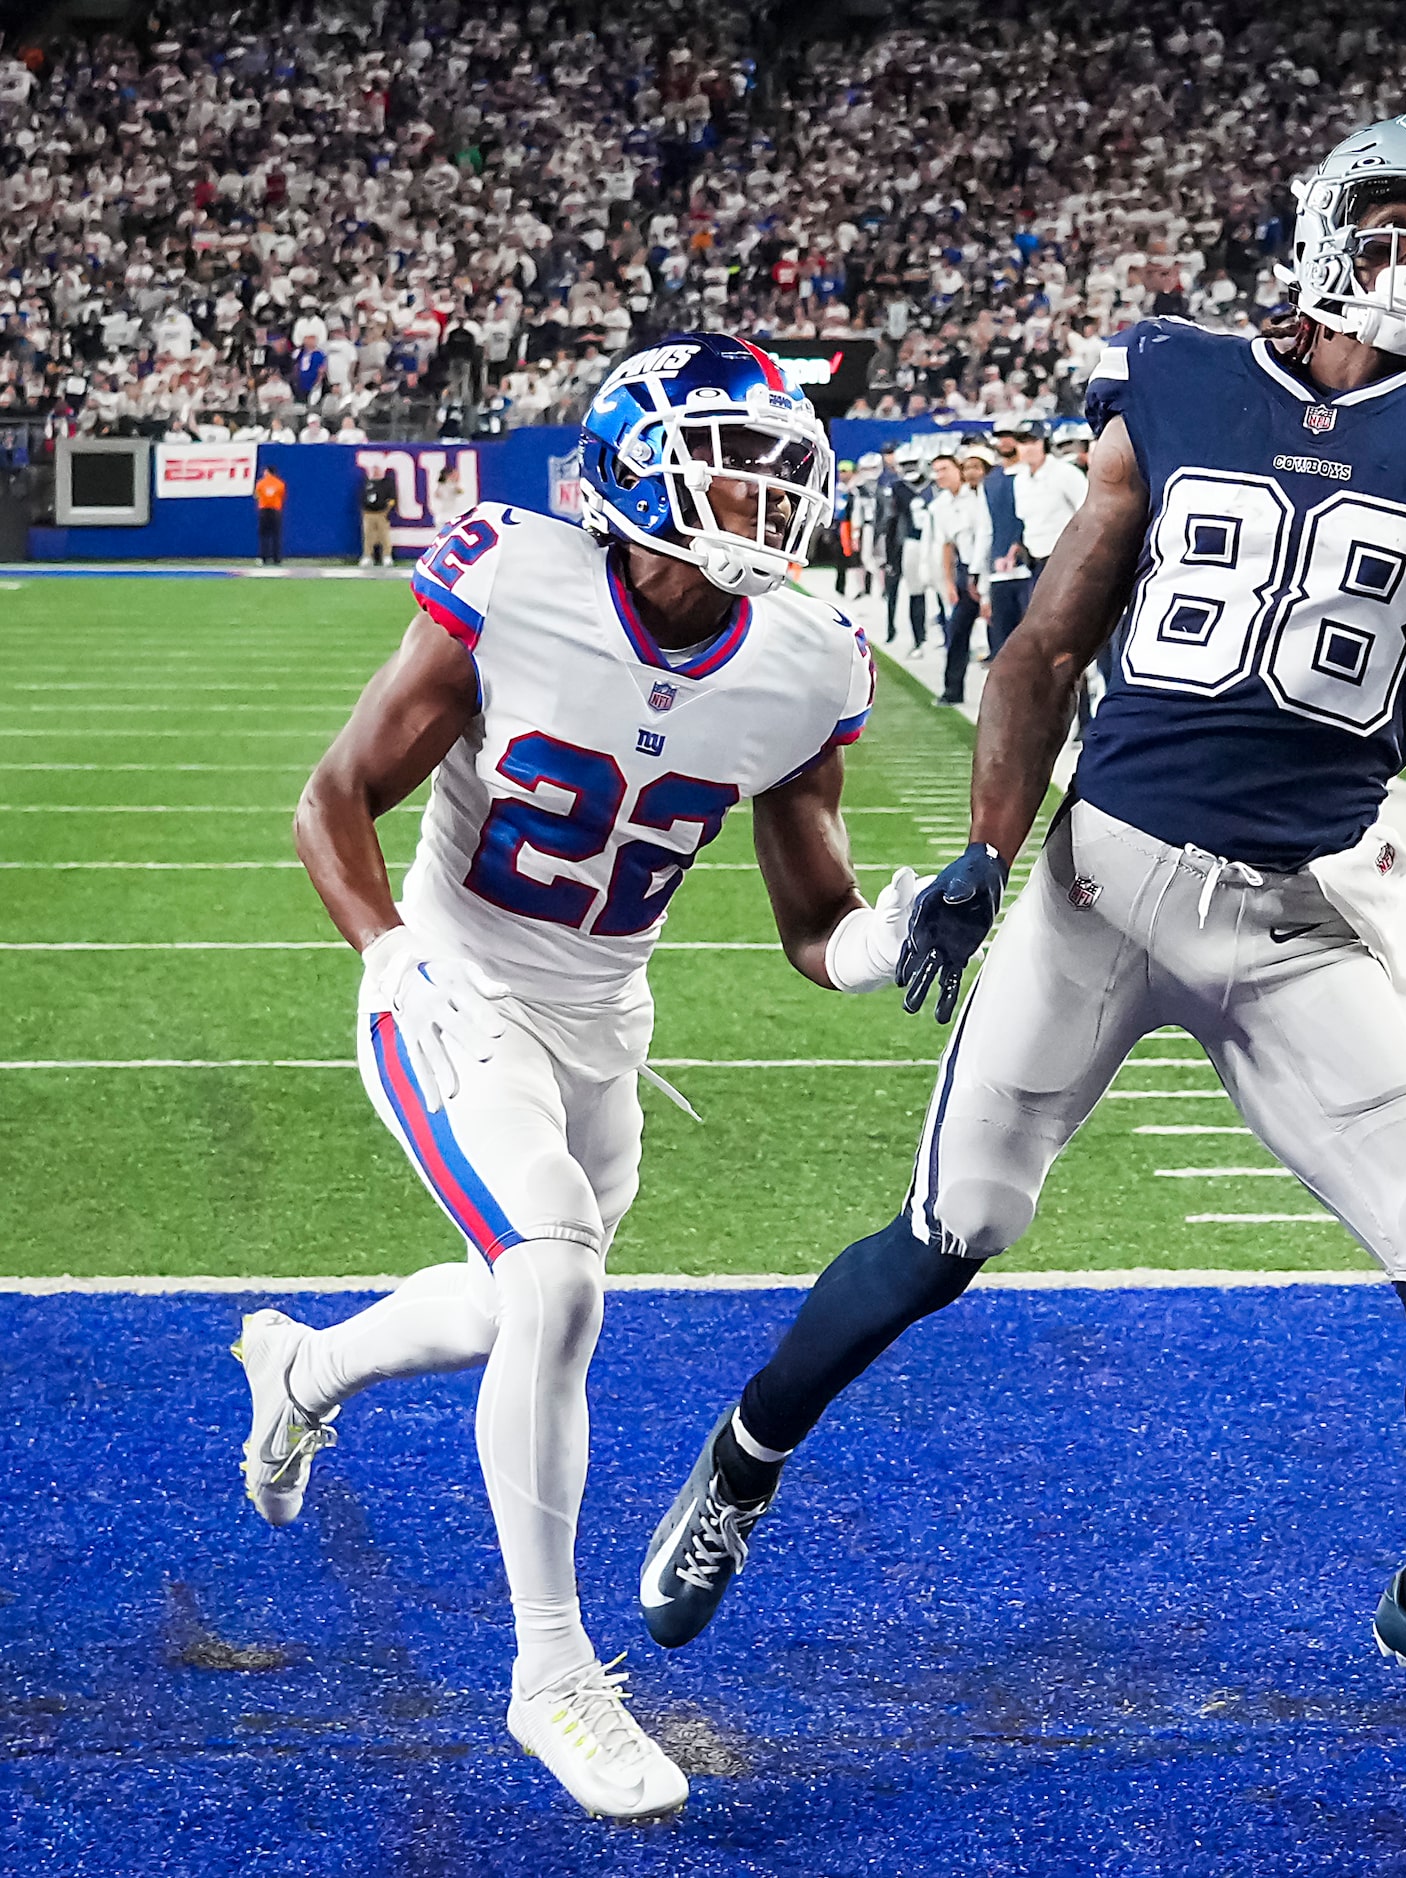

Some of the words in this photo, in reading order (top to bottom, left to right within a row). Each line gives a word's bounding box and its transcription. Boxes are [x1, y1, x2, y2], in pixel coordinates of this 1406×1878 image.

[164, 456, 251, 481] ESPN
[1273, 454, 1352, 481] COWBOYS
[462, 730, 740, 936] 22
